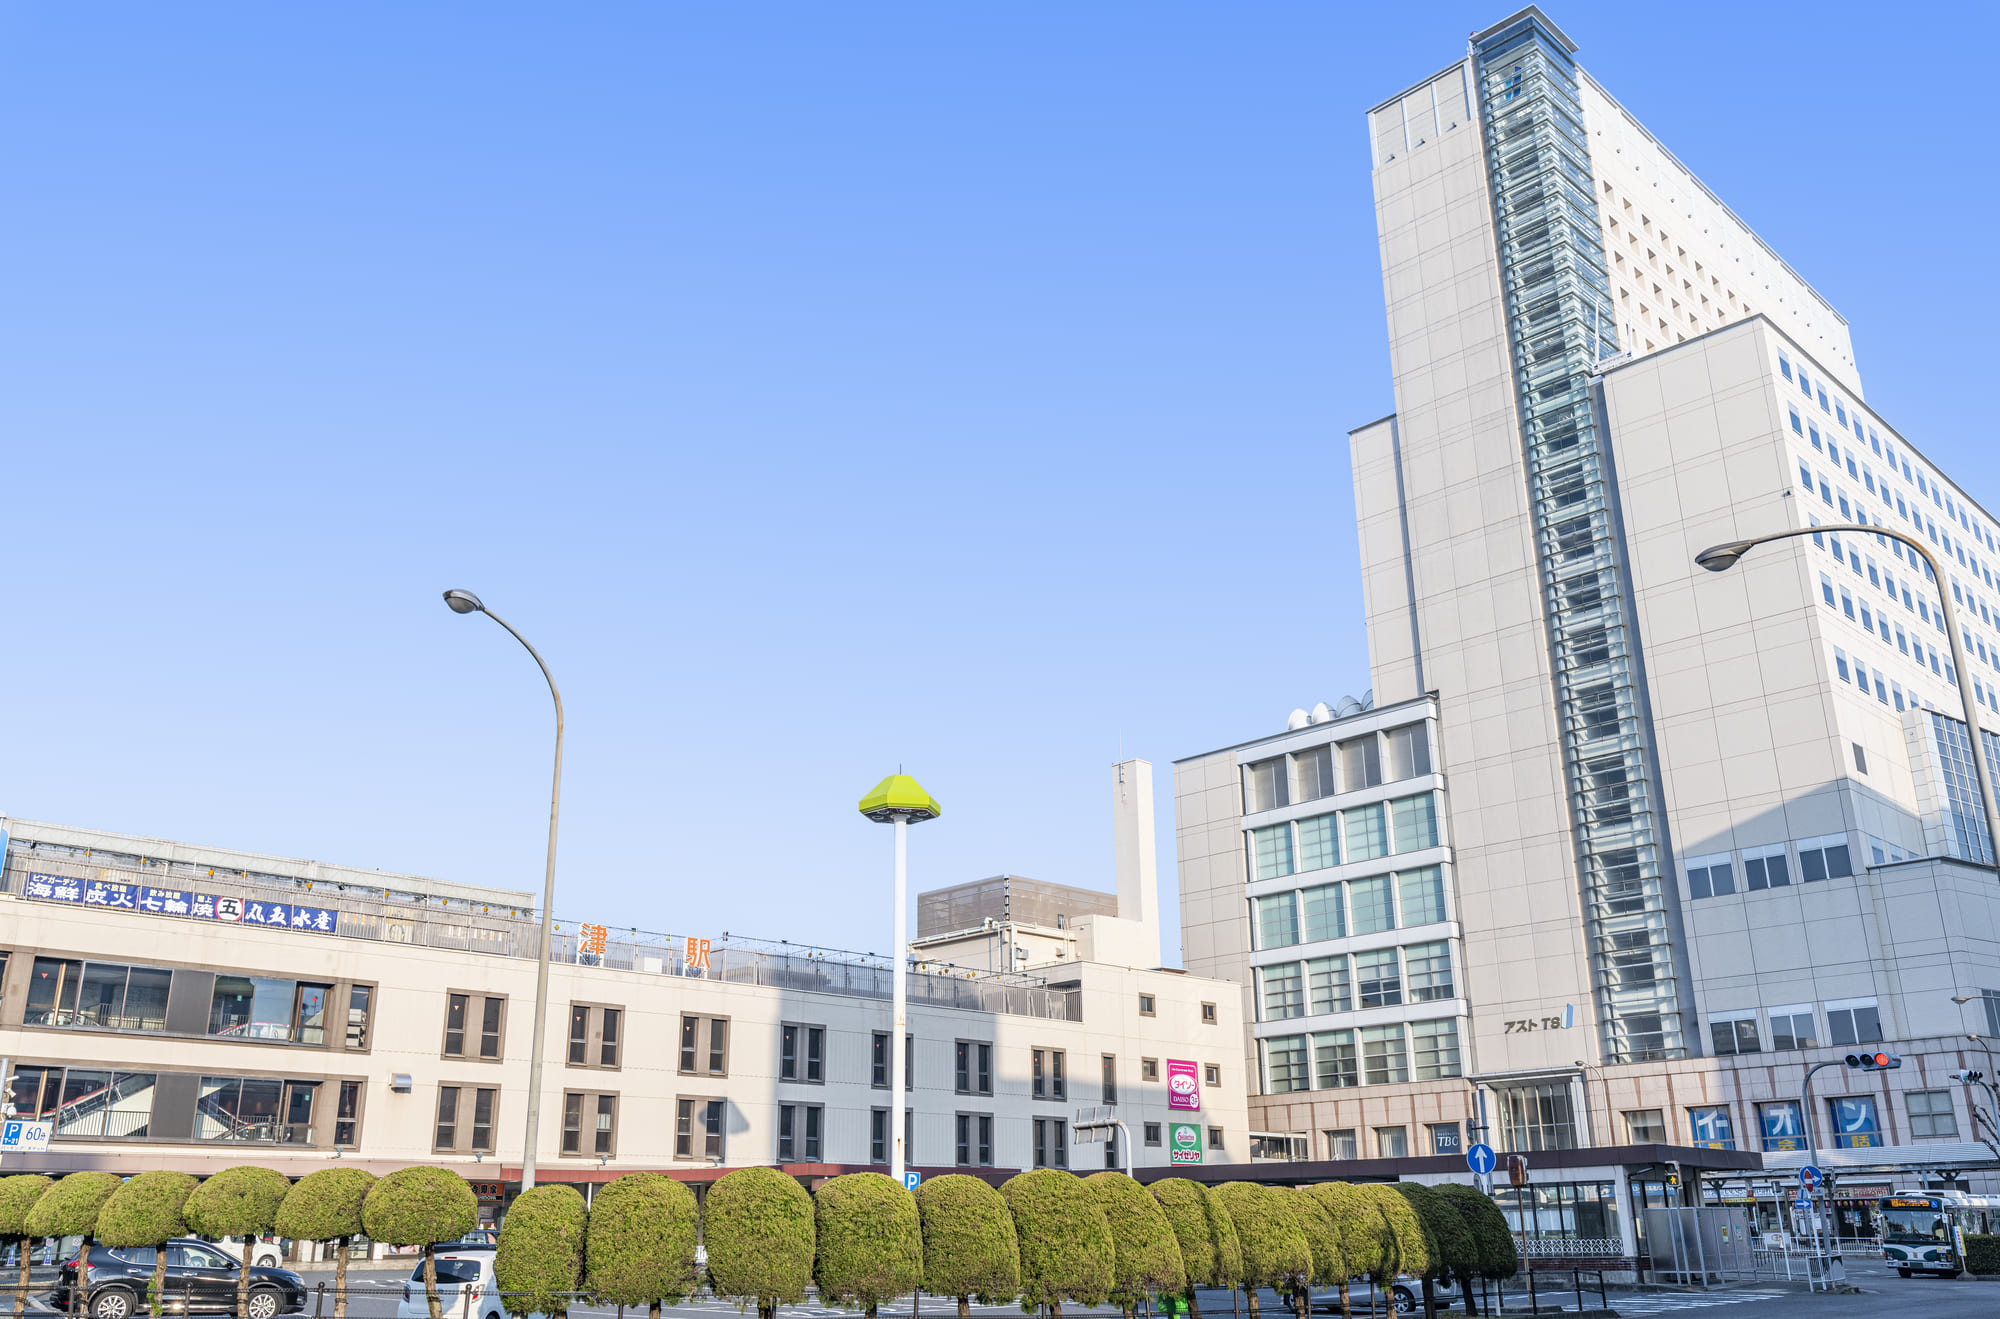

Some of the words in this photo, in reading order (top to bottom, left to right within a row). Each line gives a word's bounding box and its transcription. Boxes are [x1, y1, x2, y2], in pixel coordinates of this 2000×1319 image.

[32, 874, 78, 887] ビアガーデン
[94, 881, 127, 893] 食べ放題
[149, 889, 181, 900] 飲み放題
[1504, 1019, 1538, 1034] アスト
[1173, 1095, 1189, 1103] DAISO
[9, 1124, 19, 1138] P
[26, 1127, 46, 1141] 60分
[1437, 1135, 1459, 1147] TBC
[1173, 1150, 1200, 1161] サイゼリヤ
[908, 1174, 917, 1190] P
